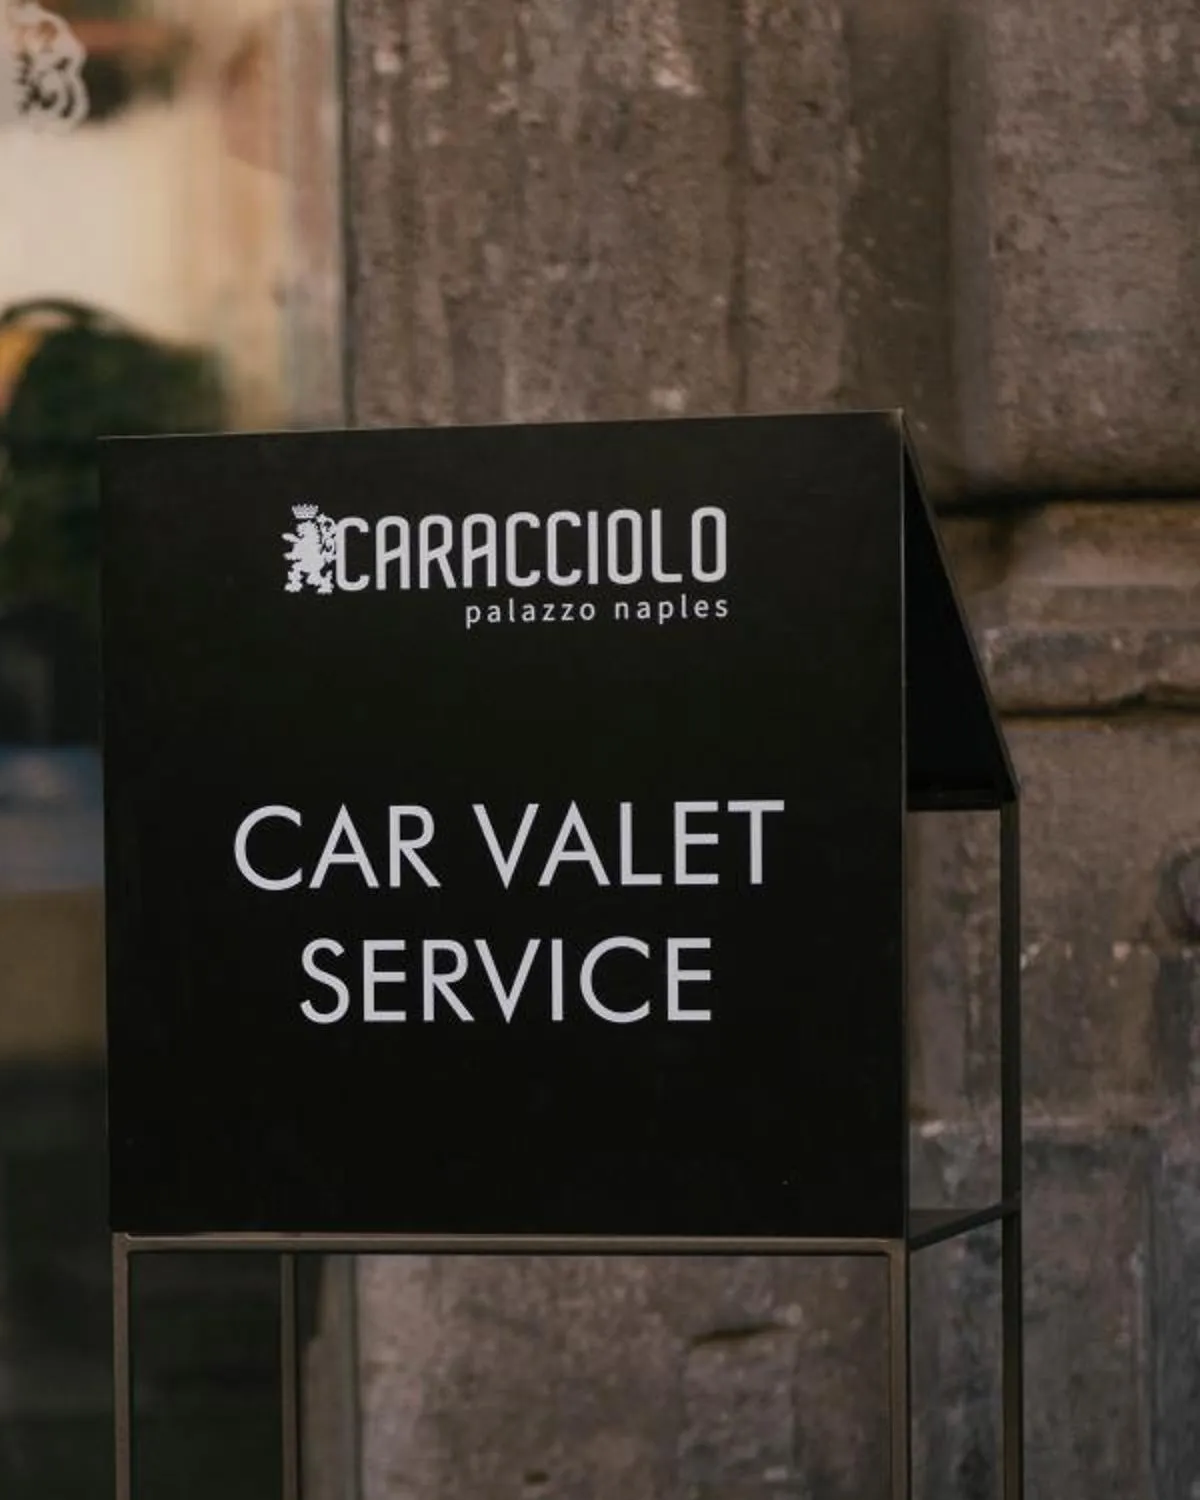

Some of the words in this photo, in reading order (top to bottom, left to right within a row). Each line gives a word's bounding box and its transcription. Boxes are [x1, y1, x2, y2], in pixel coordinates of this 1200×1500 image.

[335, 506, 728, 592] CARACCIOLO
[465, 598, 597, 630] palazzo
[613, 593, 729, 625] naples
[233, 803, 441, 892] CAR
[472, 799, 786, 889] VALET
[300, 935, 713, 1024] SERVICE
